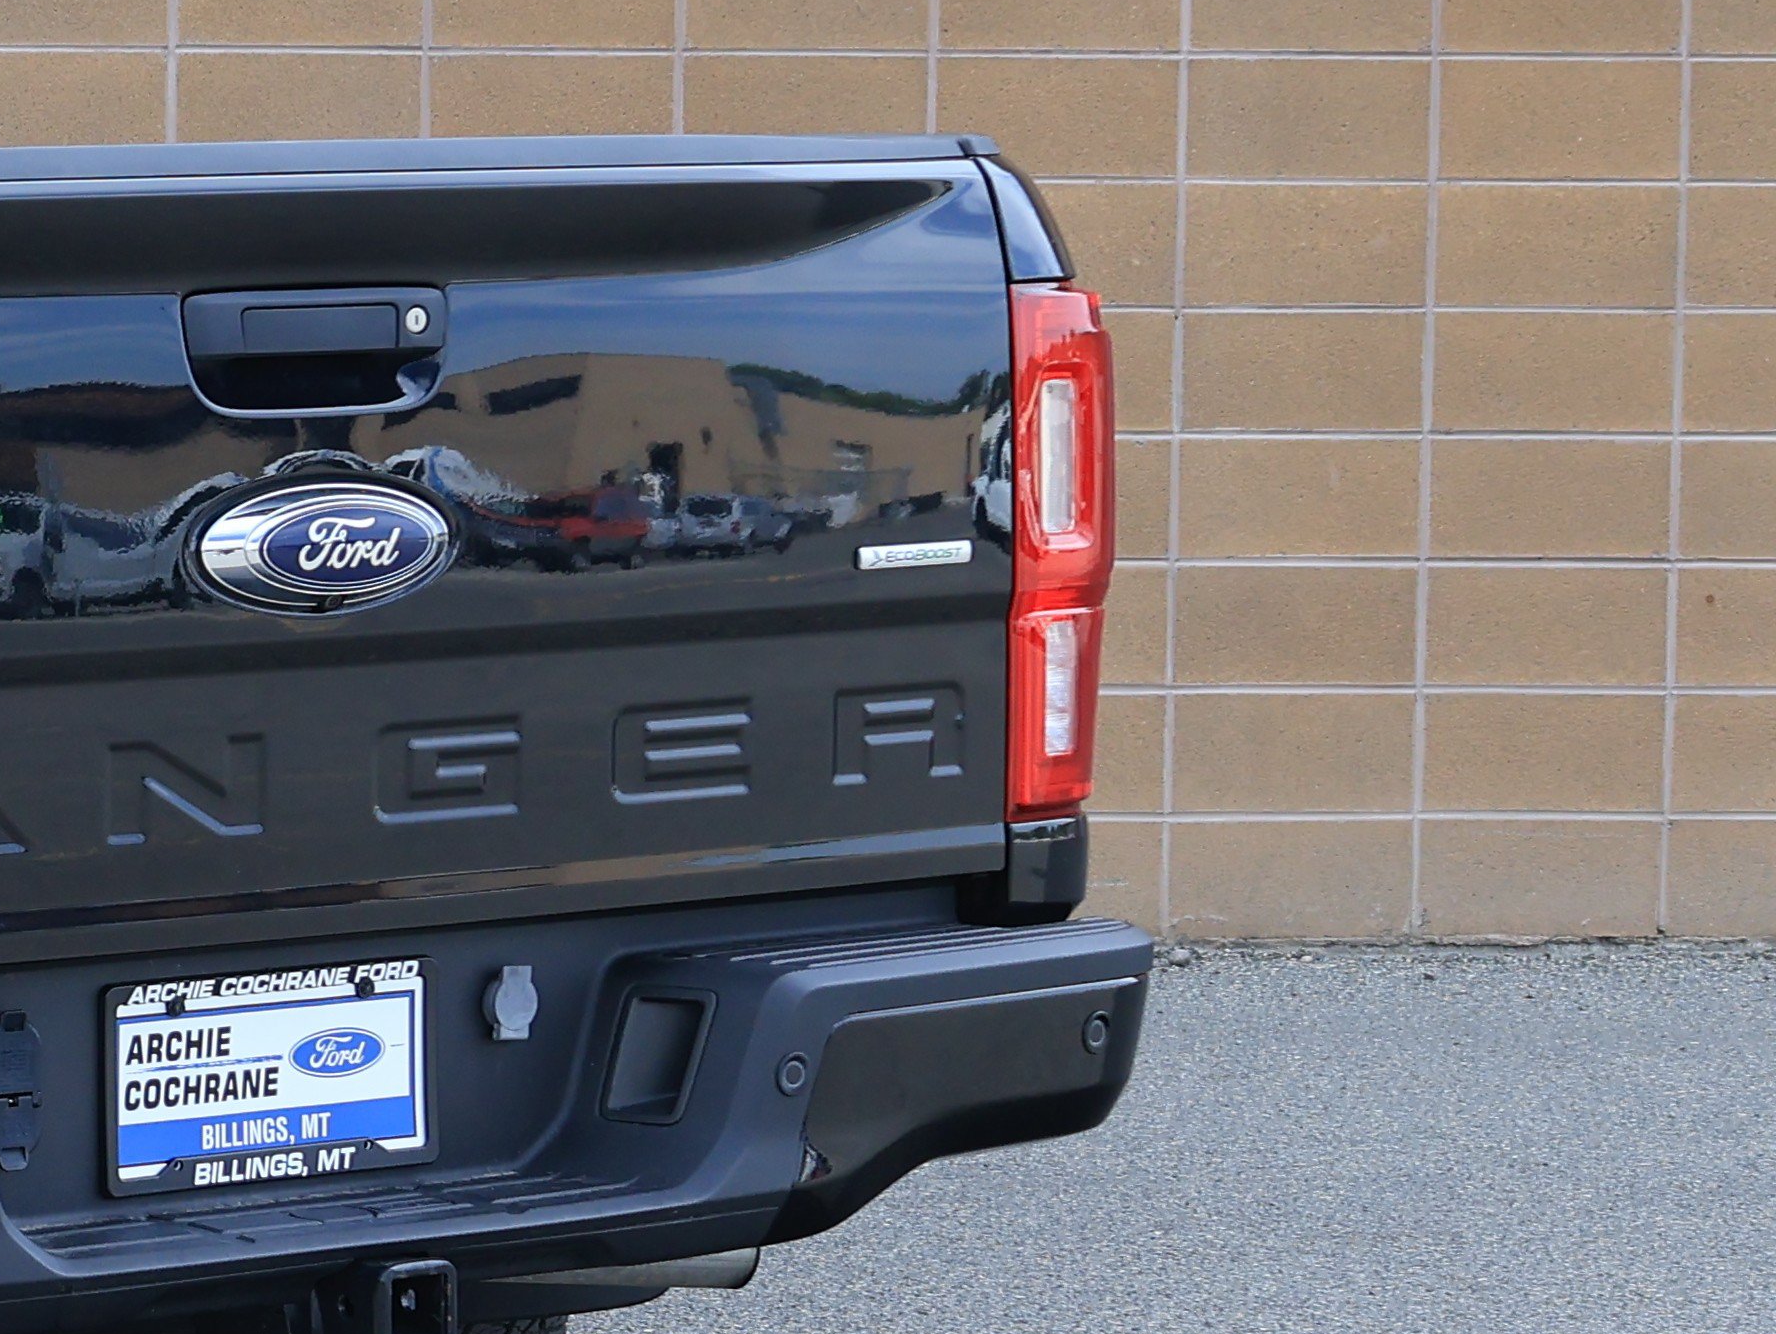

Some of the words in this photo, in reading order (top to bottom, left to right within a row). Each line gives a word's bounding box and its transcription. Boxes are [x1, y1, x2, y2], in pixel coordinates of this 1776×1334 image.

[298, 517, 401, 571] Ford
[127, 978, 216, 1006] ARCHIE
[219, 966, 351, 997] COCHRANE
[354, 959, 420, 985] FORD
[125, 1026, 232, 1066] ARCHIE
[309, 1035, 365, 1069] Ford
[124, 1066, 279, 1111] COCHRANE
[201, 1117, 296, 1151] BILLINGS,
[301, 1112, 331, 1140] MT
[194, 1153, 309, 1187] BILLINGS,
[317, 1147, 356, 1172] MT
